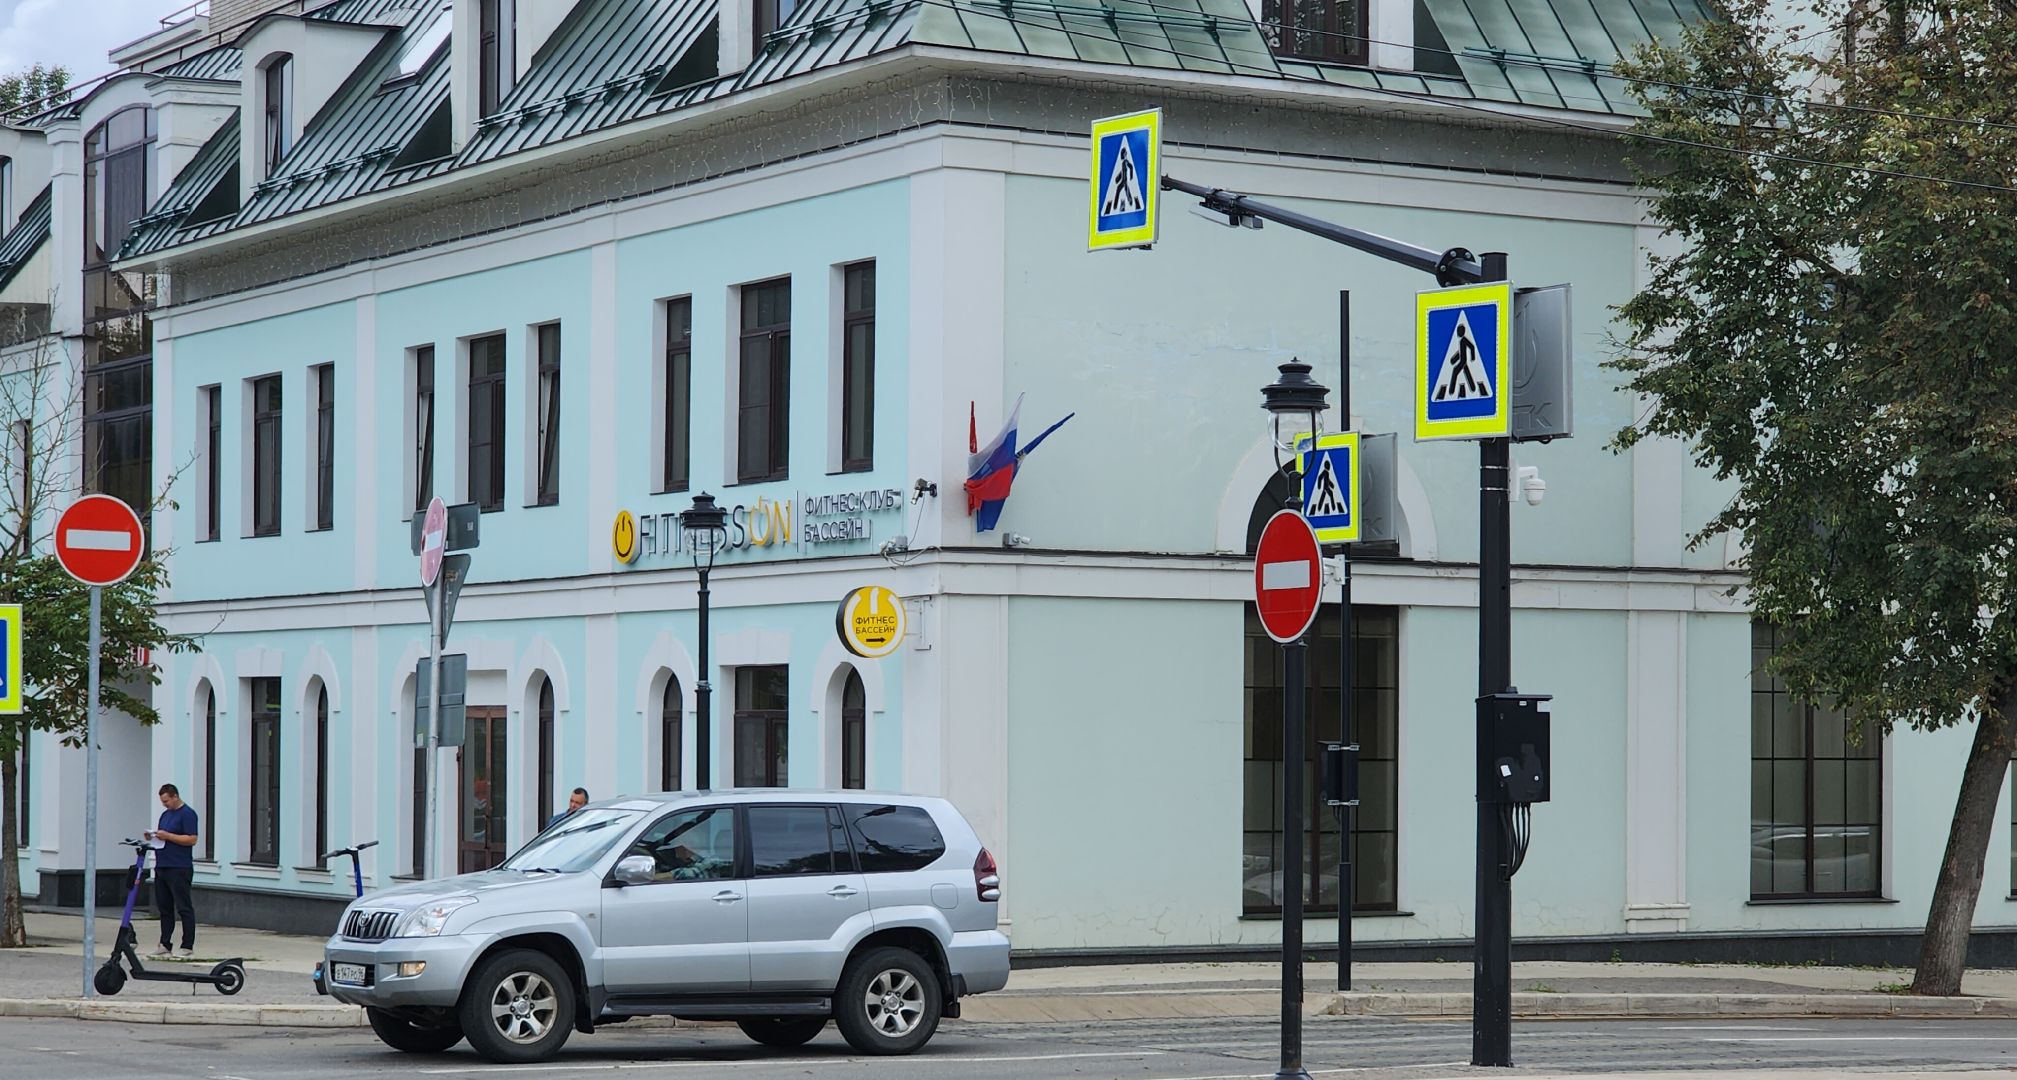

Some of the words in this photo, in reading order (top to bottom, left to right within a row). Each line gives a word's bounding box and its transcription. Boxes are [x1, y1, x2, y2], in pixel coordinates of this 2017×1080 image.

[640, 496, 792, 555] FITSSON
[804, 517, 863, 543] БАССЕЙН
[855, 616, 895, 625] ФИТНЕС
[855, 624, 896, 634] БАССЕЙН
